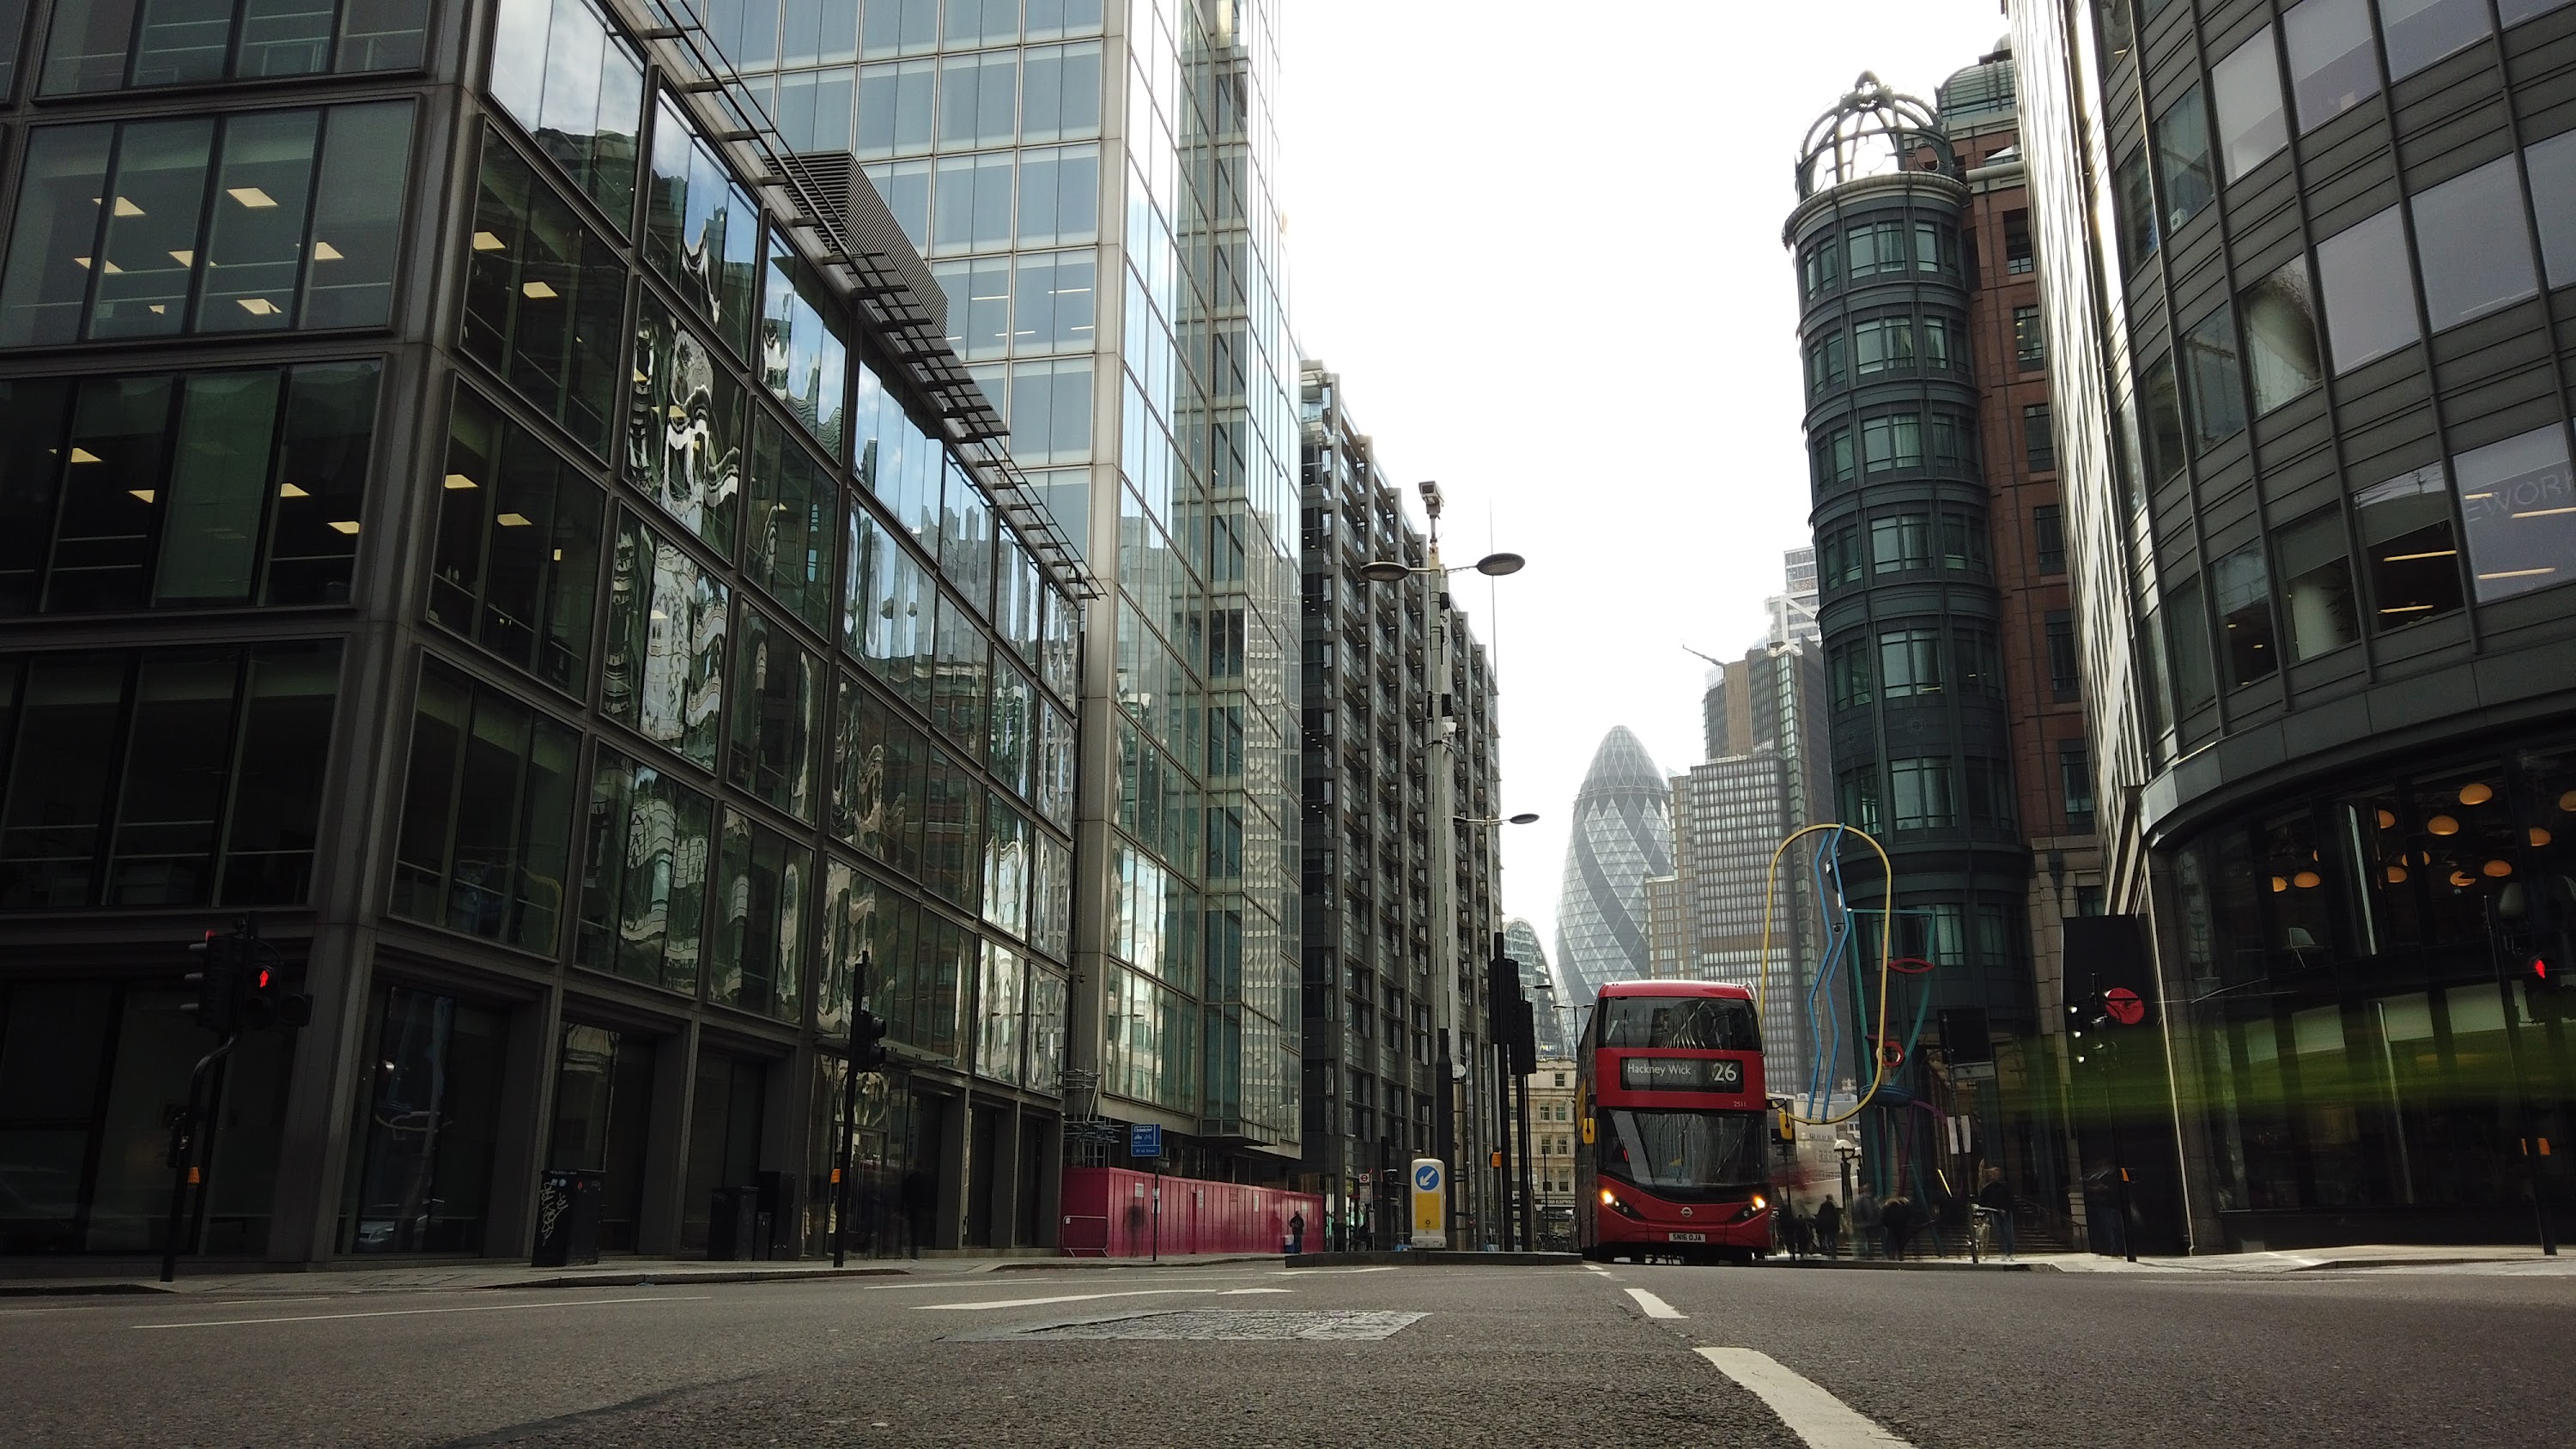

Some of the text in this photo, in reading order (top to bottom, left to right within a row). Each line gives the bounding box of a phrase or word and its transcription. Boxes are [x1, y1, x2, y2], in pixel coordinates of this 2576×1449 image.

[1627, 1064, 1692, 1076] Hackney Wick
[1712, 1063, 1737, 1082] 26
